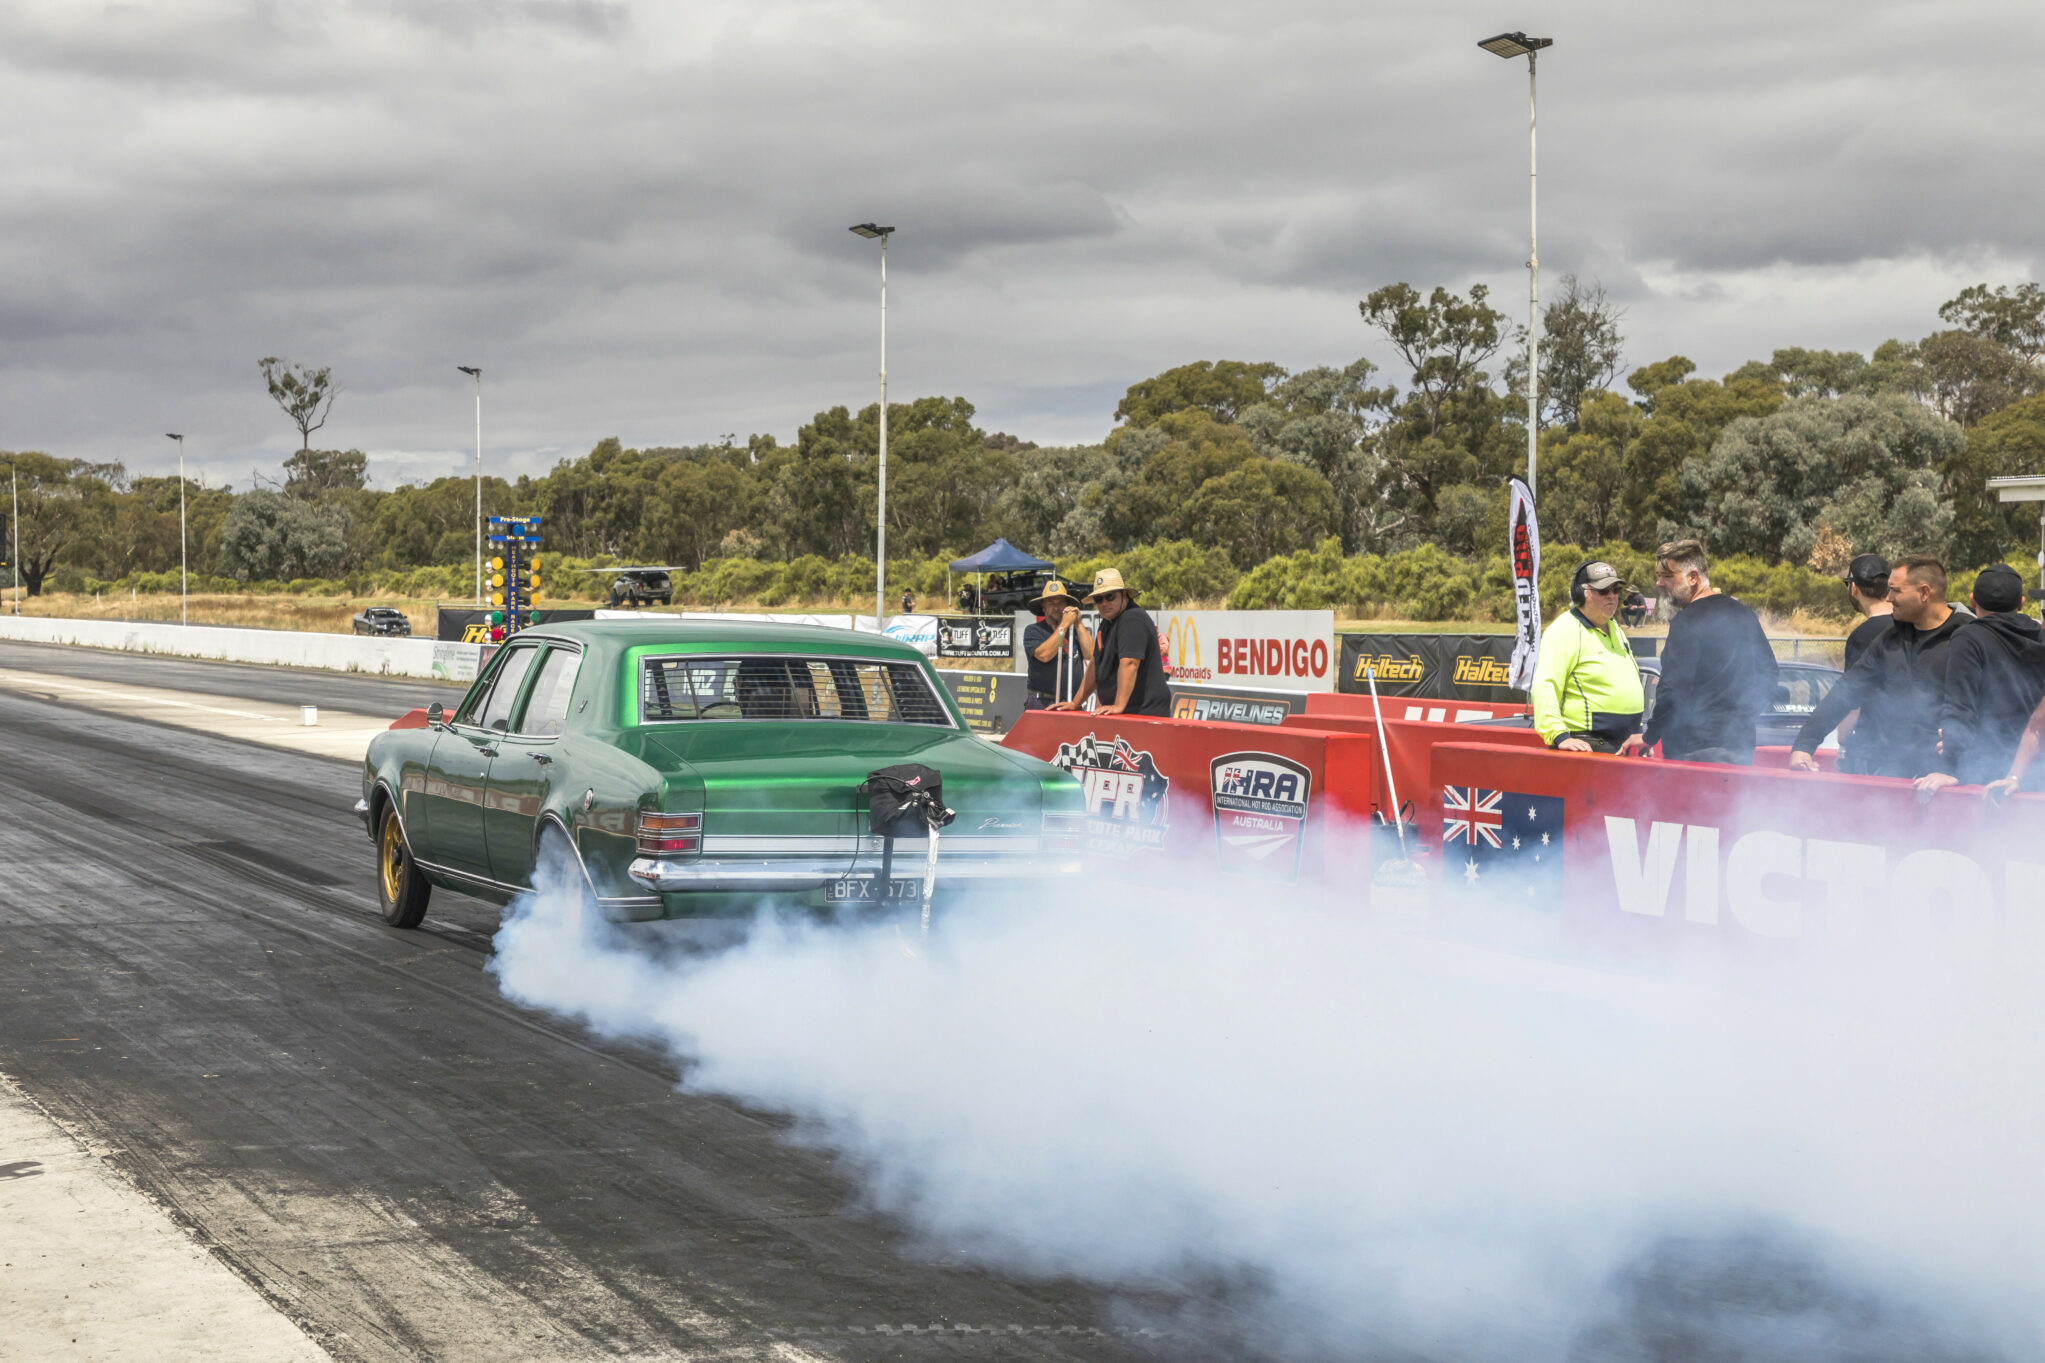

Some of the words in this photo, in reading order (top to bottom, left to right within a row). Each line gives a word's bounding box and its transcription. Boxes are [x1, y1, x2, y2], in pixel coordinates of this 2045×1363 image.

[1217, 638, 1329, 678] BENDIGO
[1355, 656, 1424, 681] Haltech
[1455, 658, 1510, 683] Haltec
[1222, 767, 1299, 801] IHRA
[1216, 796, 1251, 809] INTERNATIONAL
[1251, 800, 1261, 810] HOT
[1261, 801, 1272, 811] ROD
[1271, 803, 1303, 815] ASSOCIATION
[1232, 815, 1284, 833] AUSTRALIA
